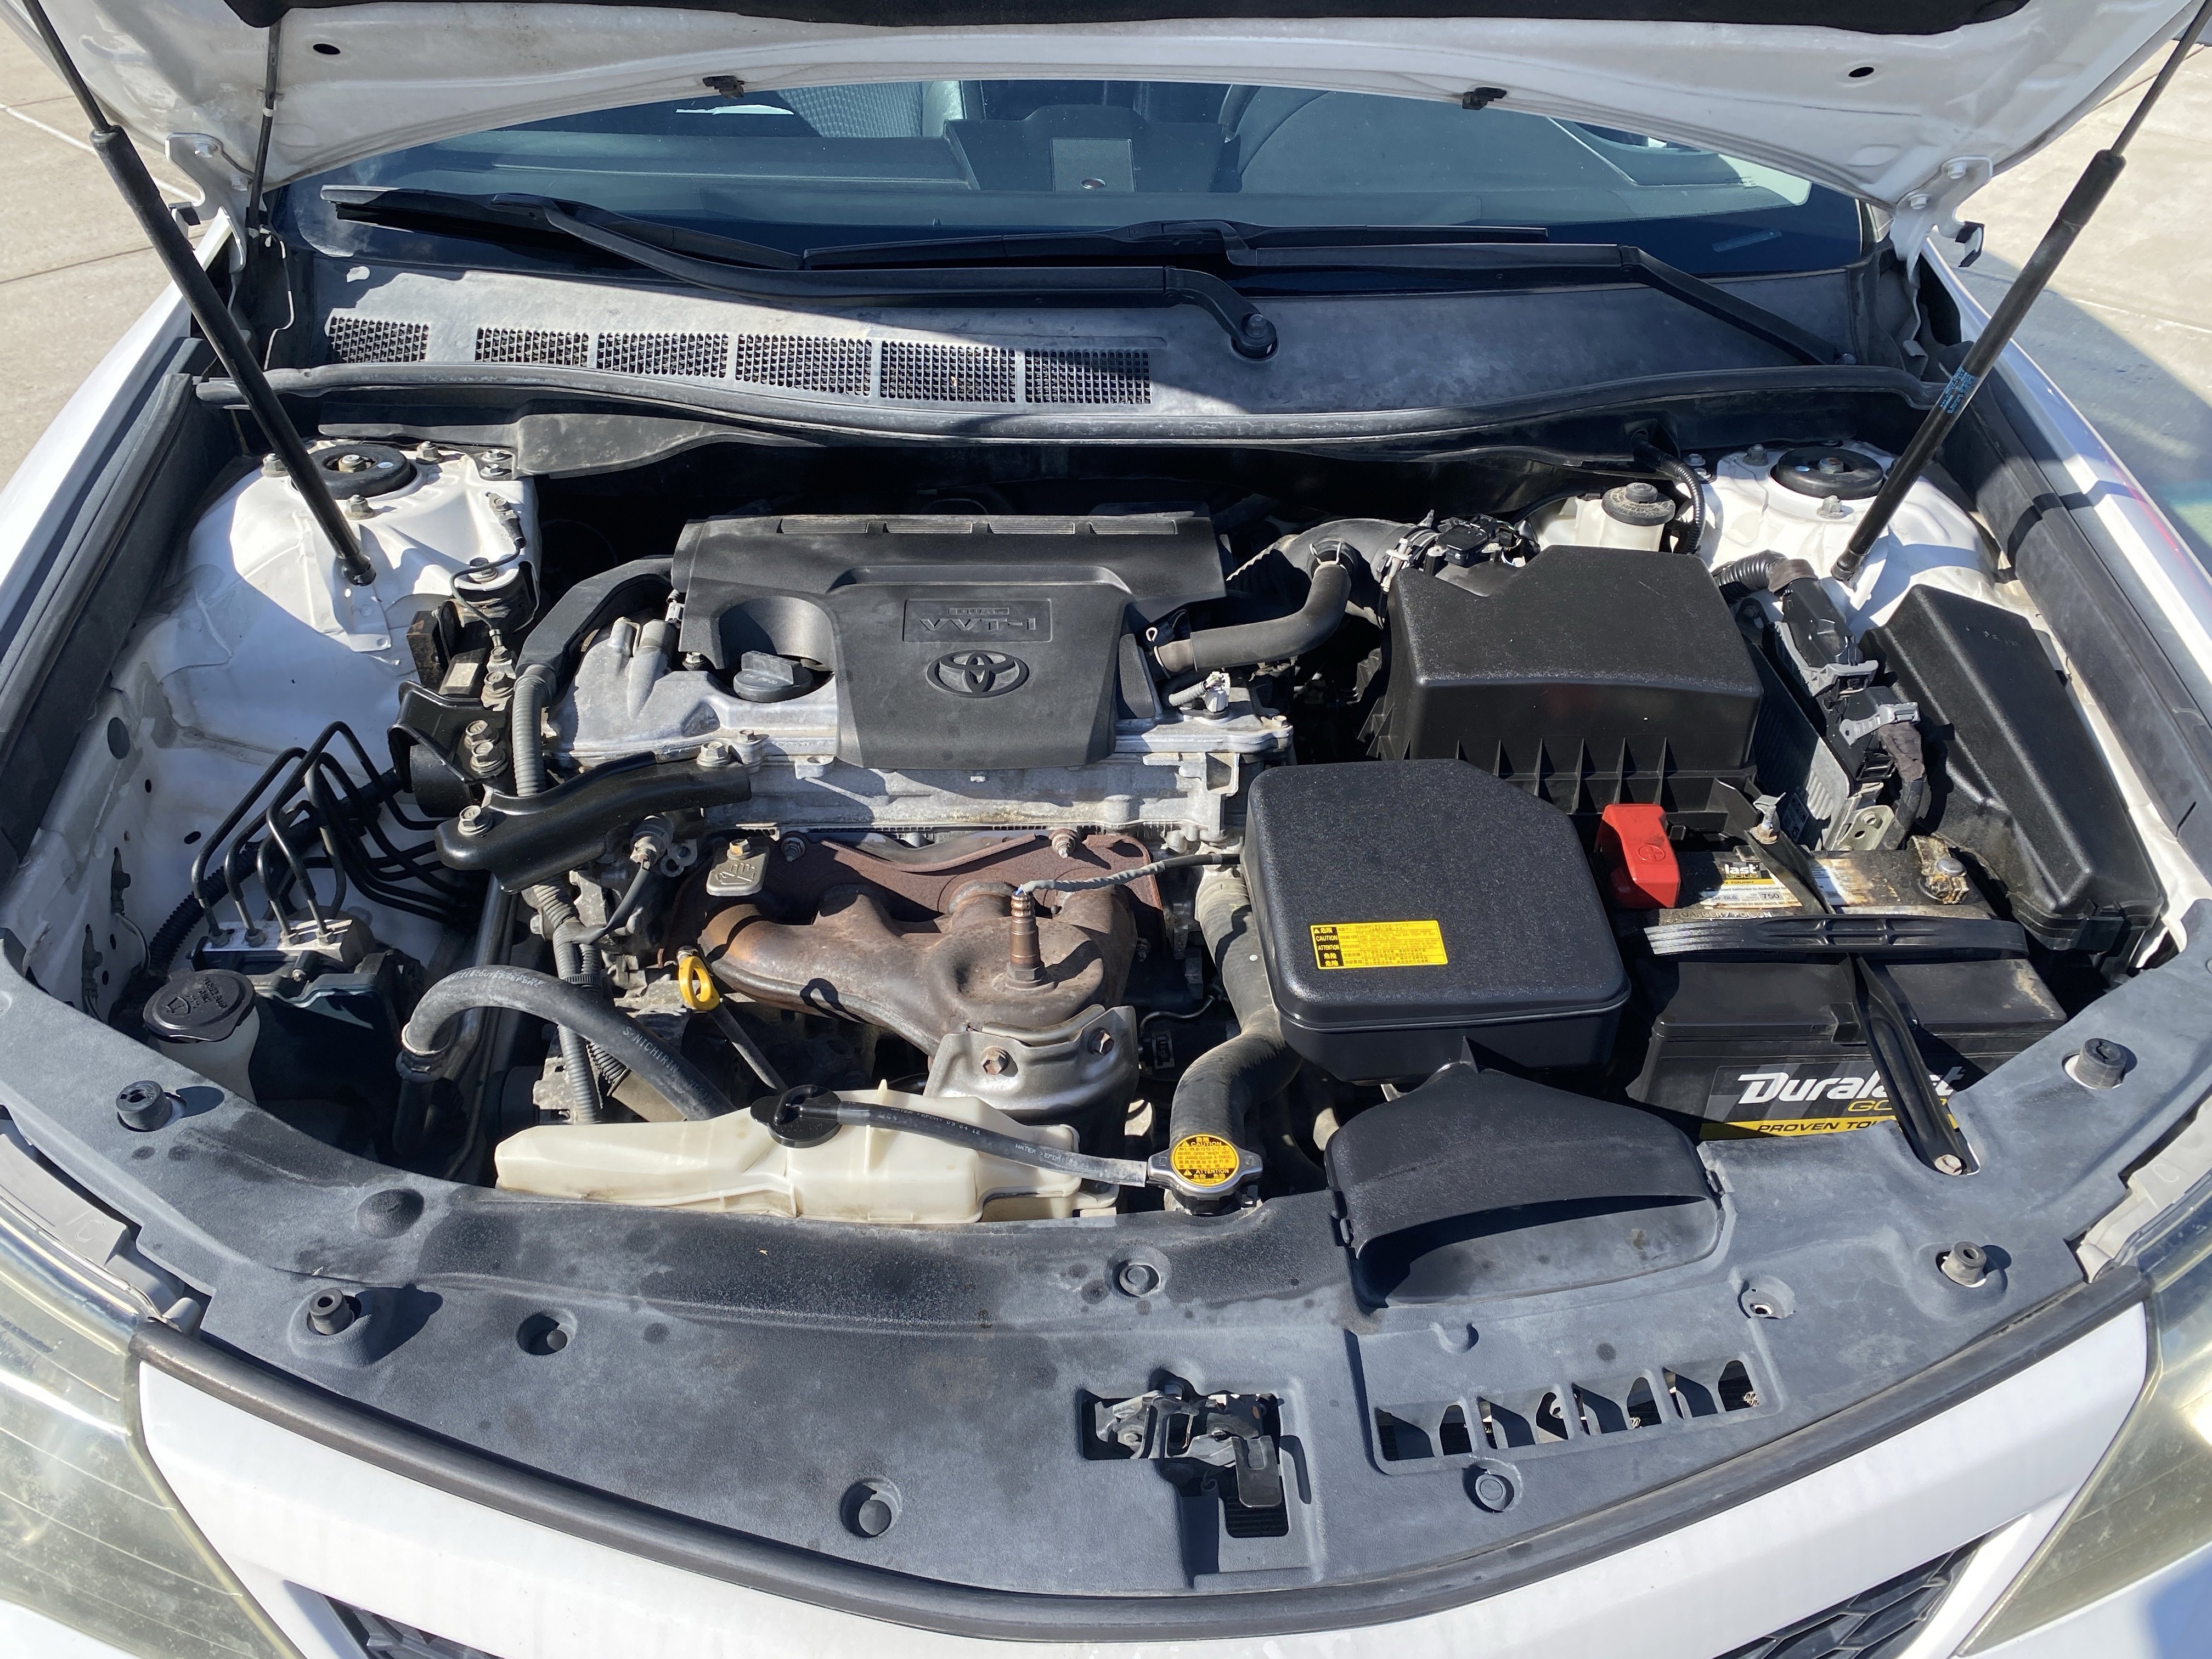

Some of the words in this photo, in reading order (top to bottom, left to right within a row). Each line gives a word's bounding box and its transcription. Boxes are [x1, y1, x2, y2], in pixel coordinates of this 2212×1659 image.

[1737, 1066, 1966, 1104] Duralt
[1757, 1121, 1841, 1133] PROVEN
[1015, 1143, 1037, 1155] WATER
